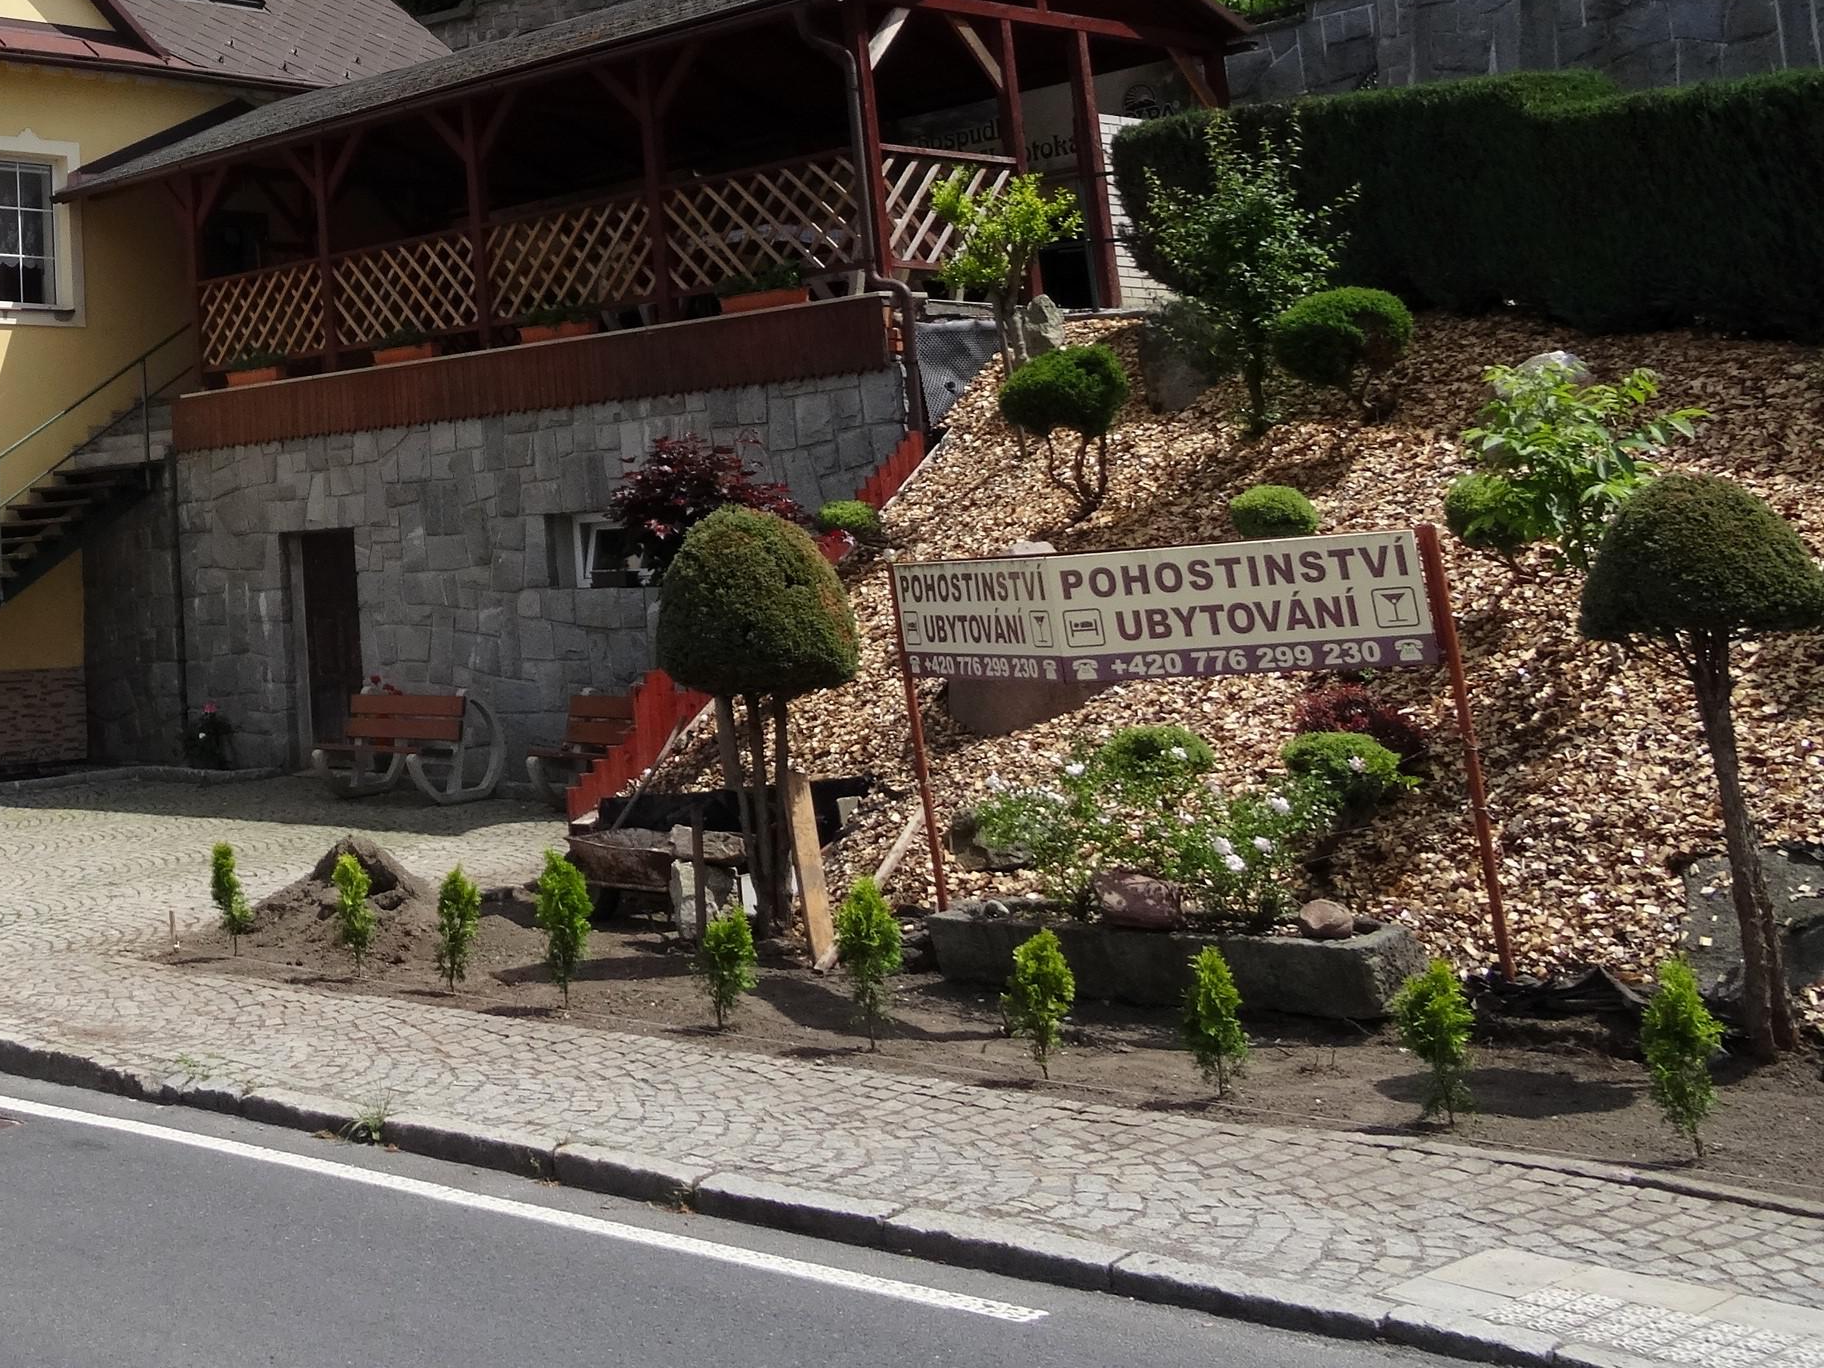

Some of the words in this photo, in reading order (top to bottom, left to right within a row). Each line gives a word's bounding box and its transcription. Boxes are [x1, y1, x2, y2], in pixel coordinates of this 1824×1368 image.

[899, 564, 1046, 603] POHOSTINSTVÍ
[1059, 537, 1409, 600] POHOSTINSTVÍ
[924, 607, 1026, 644] UBYTOVÁNÍ
[1115, 587, 1360, 641] UBYTOVÁNÍ
[926, 655, 954, 675] +420
[957, 656, 980, 676] 776
[984, 658, 1010, 677] 299
[1014, 659, 1038, 679] 230
[1111, 652, 1182, 677] +420
[1191, 649, 1247, 673] 776
[1256, 645, 1314, 670] 299
[1323, 641, 1381, 666] 230
